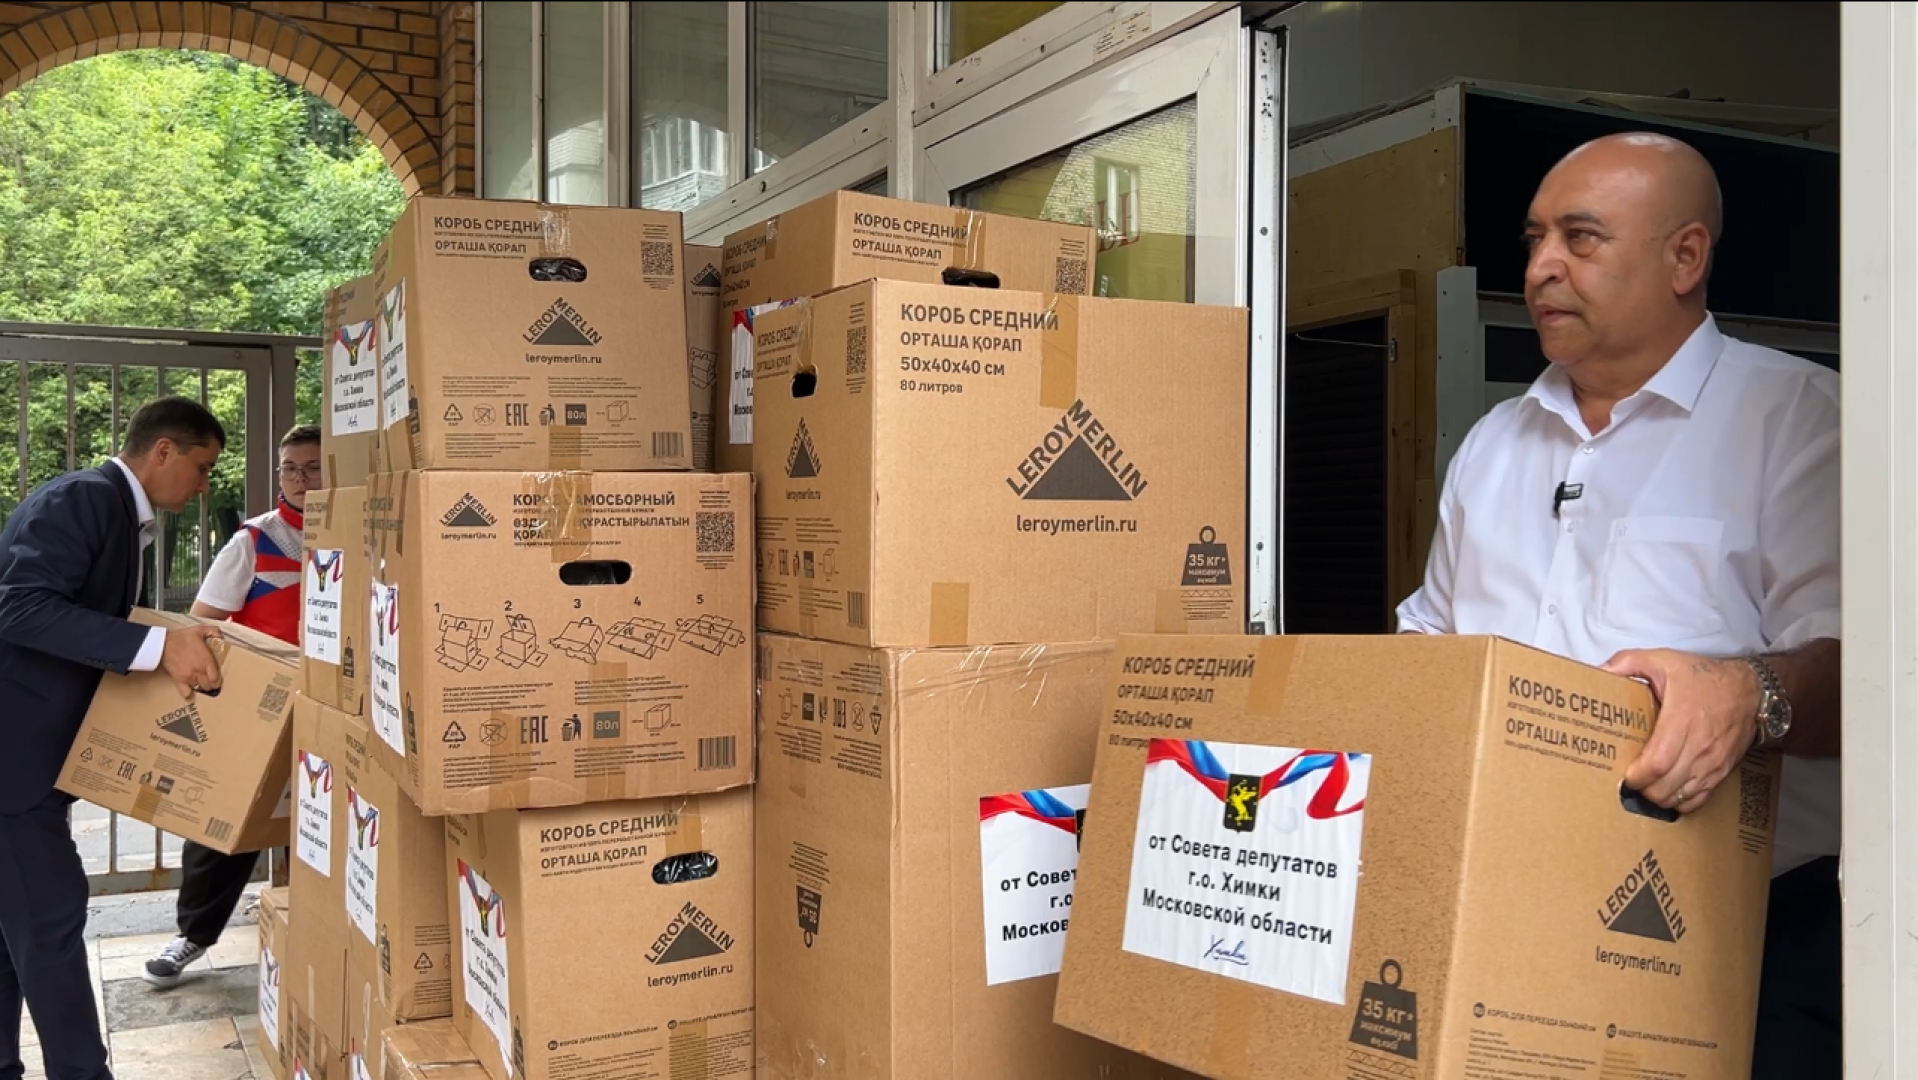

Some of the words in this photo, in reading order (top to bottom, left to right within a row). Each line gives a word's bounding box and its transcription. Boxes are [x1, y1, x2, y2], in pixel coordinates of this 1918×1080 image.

[434, 216, 481, 229] КОРОБ
[485, 218, 553, 234] СРЕДНИ
[854, 211, 901, 231] КОРОБ
[903, 219, 969, 240] СРЕДНИЙ
[435, 240, 485, 252] ОРТАША
[488, 242, 527, 254] ҚОРАП
[852, 238, 902, 254] ОРТАША
[904, 244, 942, 260] ҚОРАП
[522, 303, 559, 343] LEROY
[553, 296, 603, 344] MERLIN
[900, 303, 965, 325] КОРОБ
[969, 308, 1059, 331] СРЕДНИЙ
[900, 331, 969, 348] ОРТАША
[972, 335, 1022, 352] ҚОРАП
[525, 353, 603, 365] leroymerlin.ru
[984, 363, 1005, 375] см
[900, 379, 917, 391] 80
[918, 382, 963, 395] литров
[505, 403, 529, 426] EAC
[1006, 414, 1074, 497] LEROY
[1067, 398, 1148, 498] MERLIN
[438, 498, 467, 526] LEROY
[462, 492, 498, 525] MERLIN
[564, 490, 676, 506] АМОСБОРНЫЙ
[1016, 514, 1137, 536] leroymerlin.ru
[1188, 553, 1205, 567] 35
[434, 602, 440, 613] 1
[504, 600, 513, 611] 2
[574, 599, 582, 609] 3
[634, 596, 642, 606] 4
[697, 594, 705, 604] 5
[1122, 656, 1172, 675] КОРОБ
[1175, 654, 1256, 680] СРЕДНИЙ
[1117, 684, 1169, 701] ОРТАША
[1170, 686, 1214, 704] ҚОРАП
[1508, 675, 1566, 708] КОРОБ
[1569, 692, 1649, 732] СРЕДНИЙ
[155, 706, 188, 727] LEROY
[187, 702, 208, 743] MERLIN
[521, 715, 549, 744] EAC
[596, 719, 618, 731] 80л
[1174, 717, 1193, 730] см
[1108, 734, 1121, 746] 80
[1506, 718, 1568, 748] ОРТАША
[1571, 734, 1616, 760] ҚОРАП
[540, 823, 597, 844] КОРОБ
[599, 809, 678, 835] СРЕДНИЙ
[541, 851, 600, 869] ОРТАША
[603, 844, 648, 863] ҚОРАП
[1149, 835, 1166, 850] от
[1171, 834, 1231, 861] Совета
[1236, 849, 1339, 878] депутатов
[1000, 877, 1021, 892] от
[1188, 871, 1216, 889] г.о.
[1221, 871, 1281, 902] Химки
[1597, 861, 1645, 926] LEROY
[1642, 848, 1687, 940] MERLIN
[1142, 887, 1245, 927] Московской
[1251, 912, 1333, 945] области
[644, 912, 685, 963] LEROY
[681, 901, 735, 950] MERLIN
[1595, 945, 1681, 976] leroymerlin.ru
[647, 964, 734, 987] leroymerlin.ru
[1362, 998, 1384, 1019] 35
